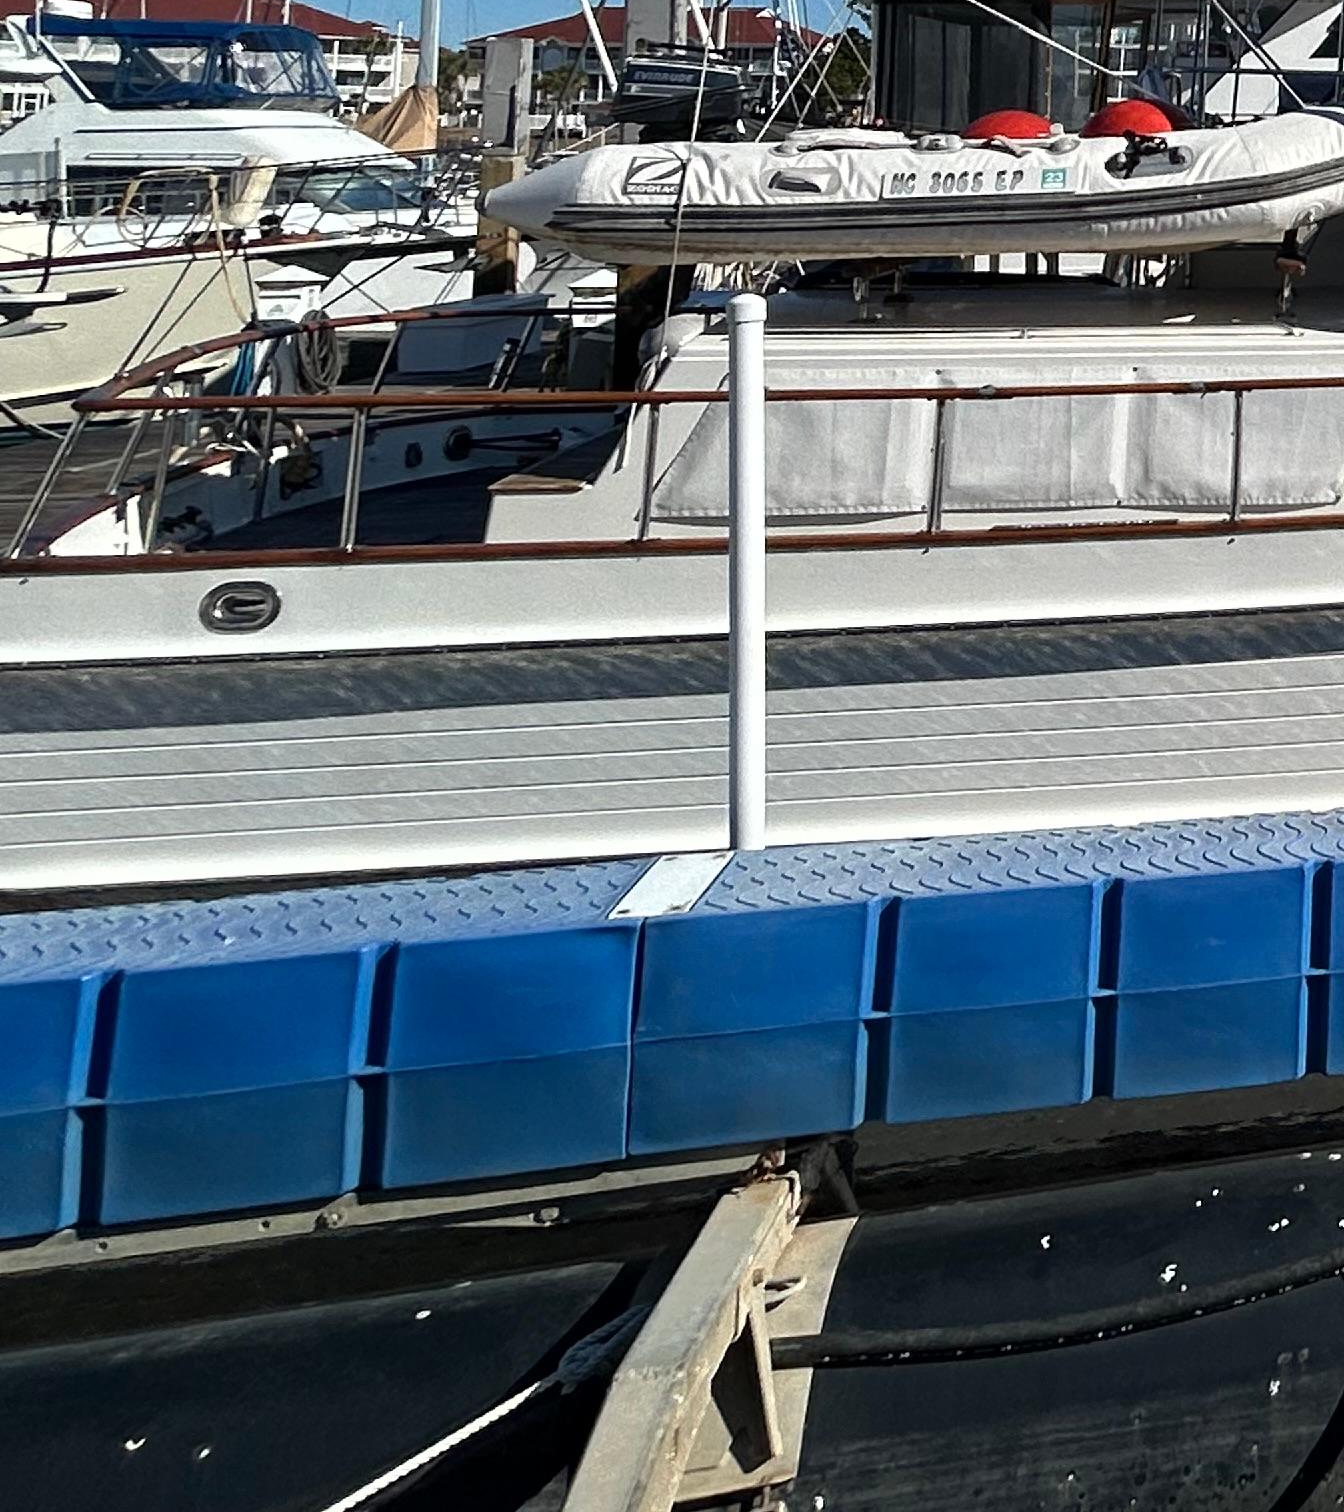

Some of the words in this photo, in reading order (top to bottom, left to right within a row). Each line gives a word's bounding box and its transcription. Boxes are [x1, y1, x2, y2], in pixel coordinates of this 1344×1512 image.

[890, 172, 917, 195] NC
[995, 169, 1024, 191] EP
[1044, 172, 1064, 182] 23
